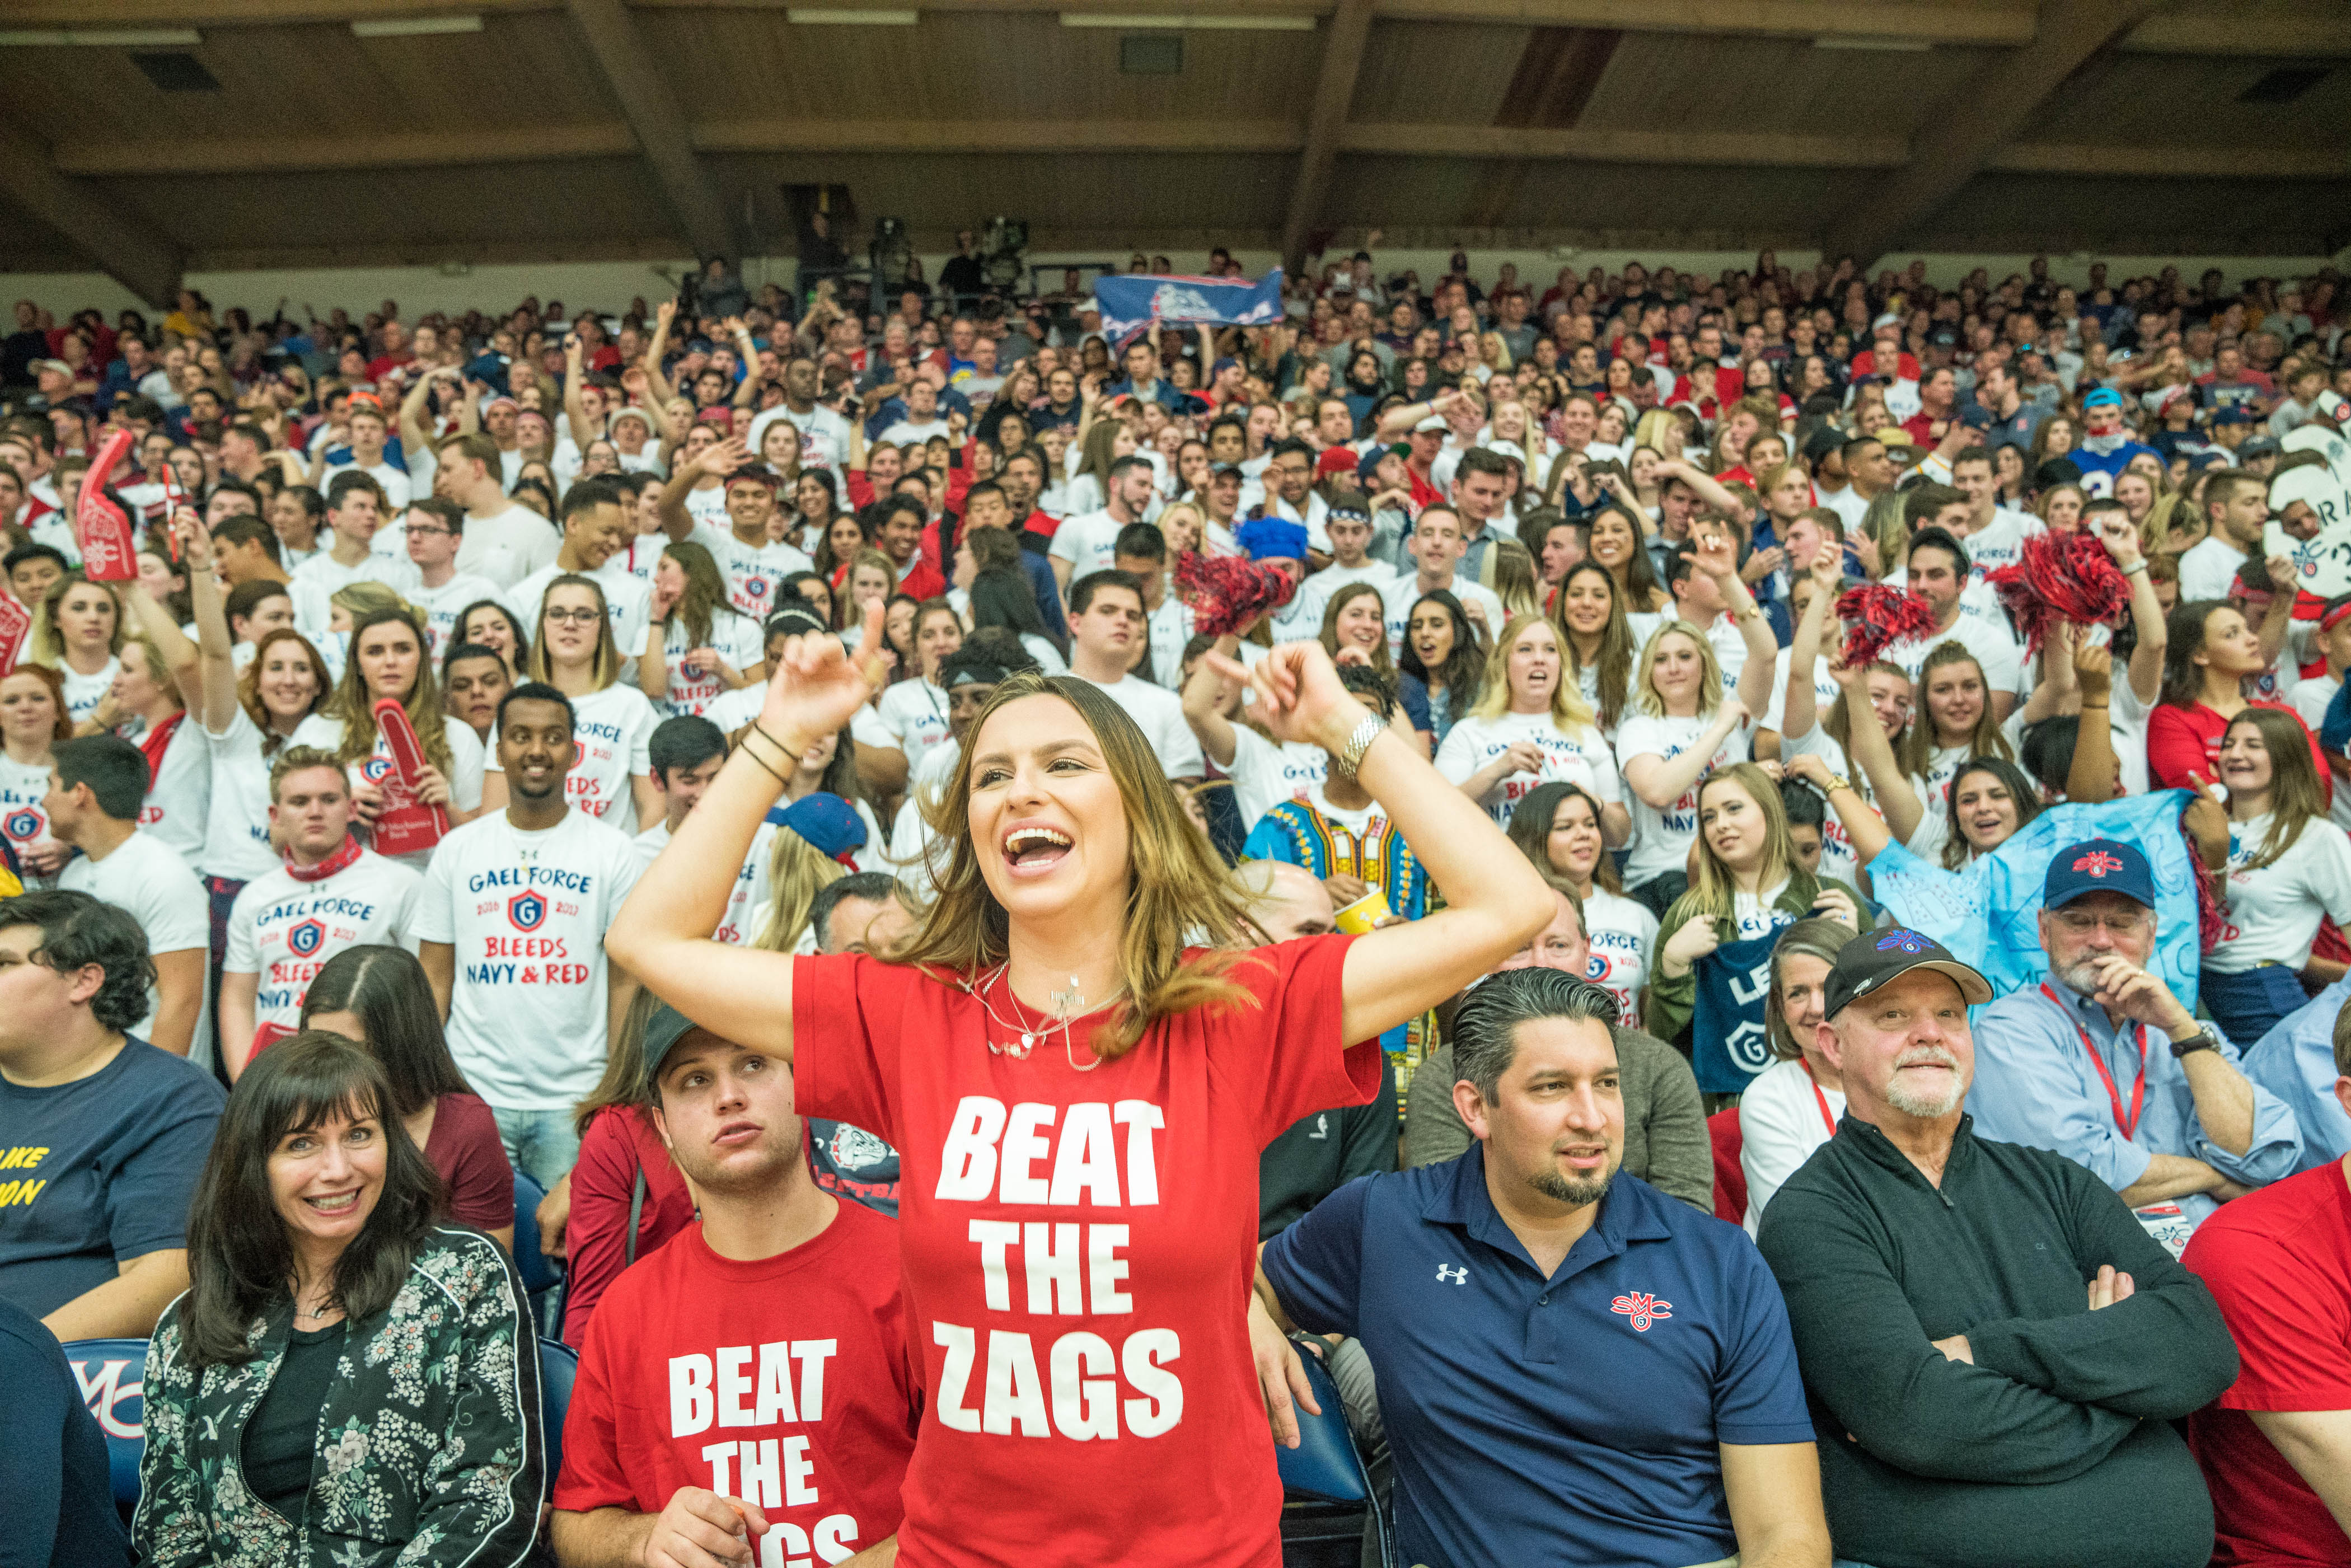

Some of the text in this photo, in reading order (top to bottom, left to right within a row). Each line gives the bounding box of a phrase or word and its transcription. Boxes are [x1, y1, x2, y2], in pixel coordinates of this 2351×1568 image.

[578, 723, 622, 743] ORCE
[1662, 815, 1693, 832] NAV
[470, 867, 592, 893] GAEL FORCE
[257, 897, 375, 926] GAEL FORCE
[484, 937, 568, 958] BLEEDS
[1591, 933, 1638, 951] ORCE
[467, 962, 589, 985] NAVY & RED
[935, 1096, 1165, 1207] BEAT
[968, 1219, 1133, 1316] THE
[1610, 1291, 1673, 1322] SMC
[668, 1338, 837, 1439] BEAT
[933, 1320, 1184, 1441] ZAGS
[702, 1435, 819, 1509] THE
[750, 1514, 859, 1568] GS
